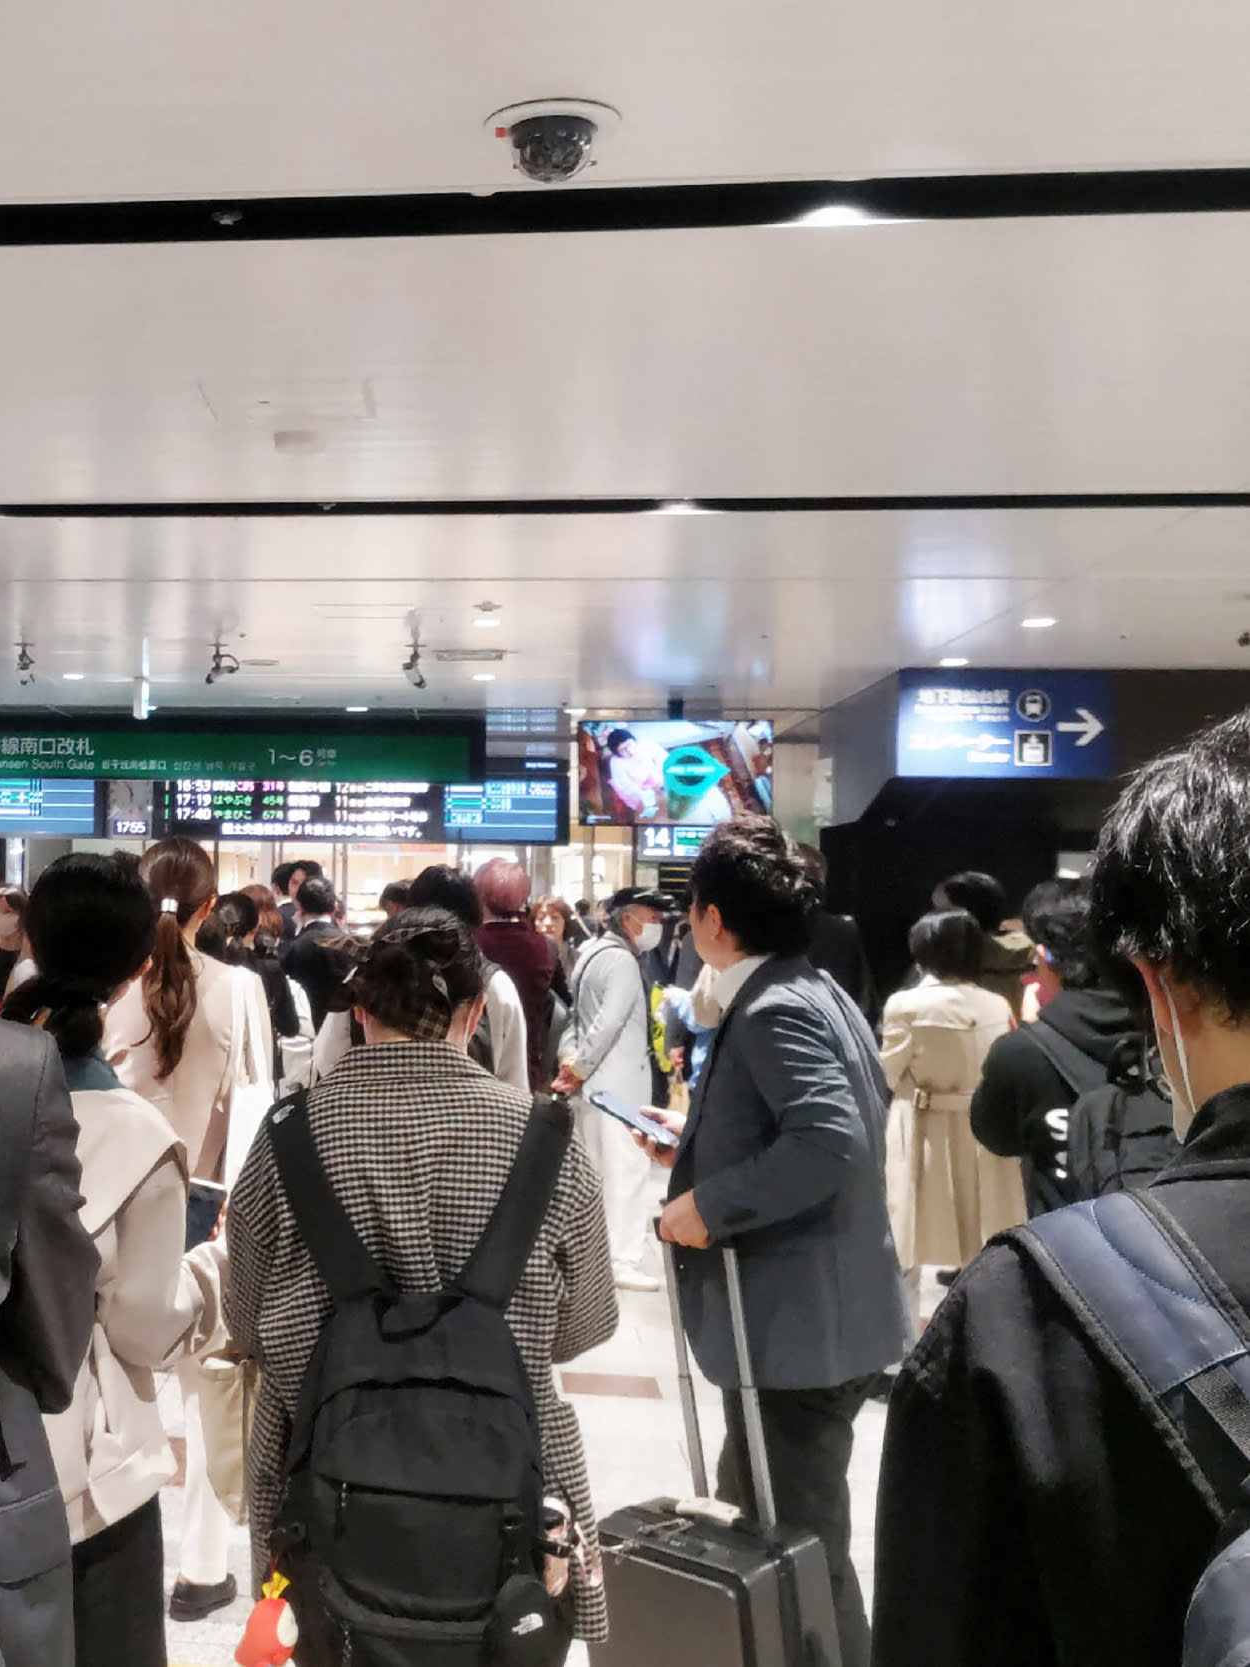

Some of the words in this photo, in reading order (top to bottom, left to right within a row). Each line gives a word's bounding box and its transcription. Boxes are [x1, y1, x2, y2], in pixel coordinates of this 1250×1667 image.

[31, 757, 65, 770] South
[66, 757, 95, 770] Gate
[212, 794, 253, 806] はやぶさ
[212, 809, 253, 820] やまびこ
[644, 826, 671, 848] 14
